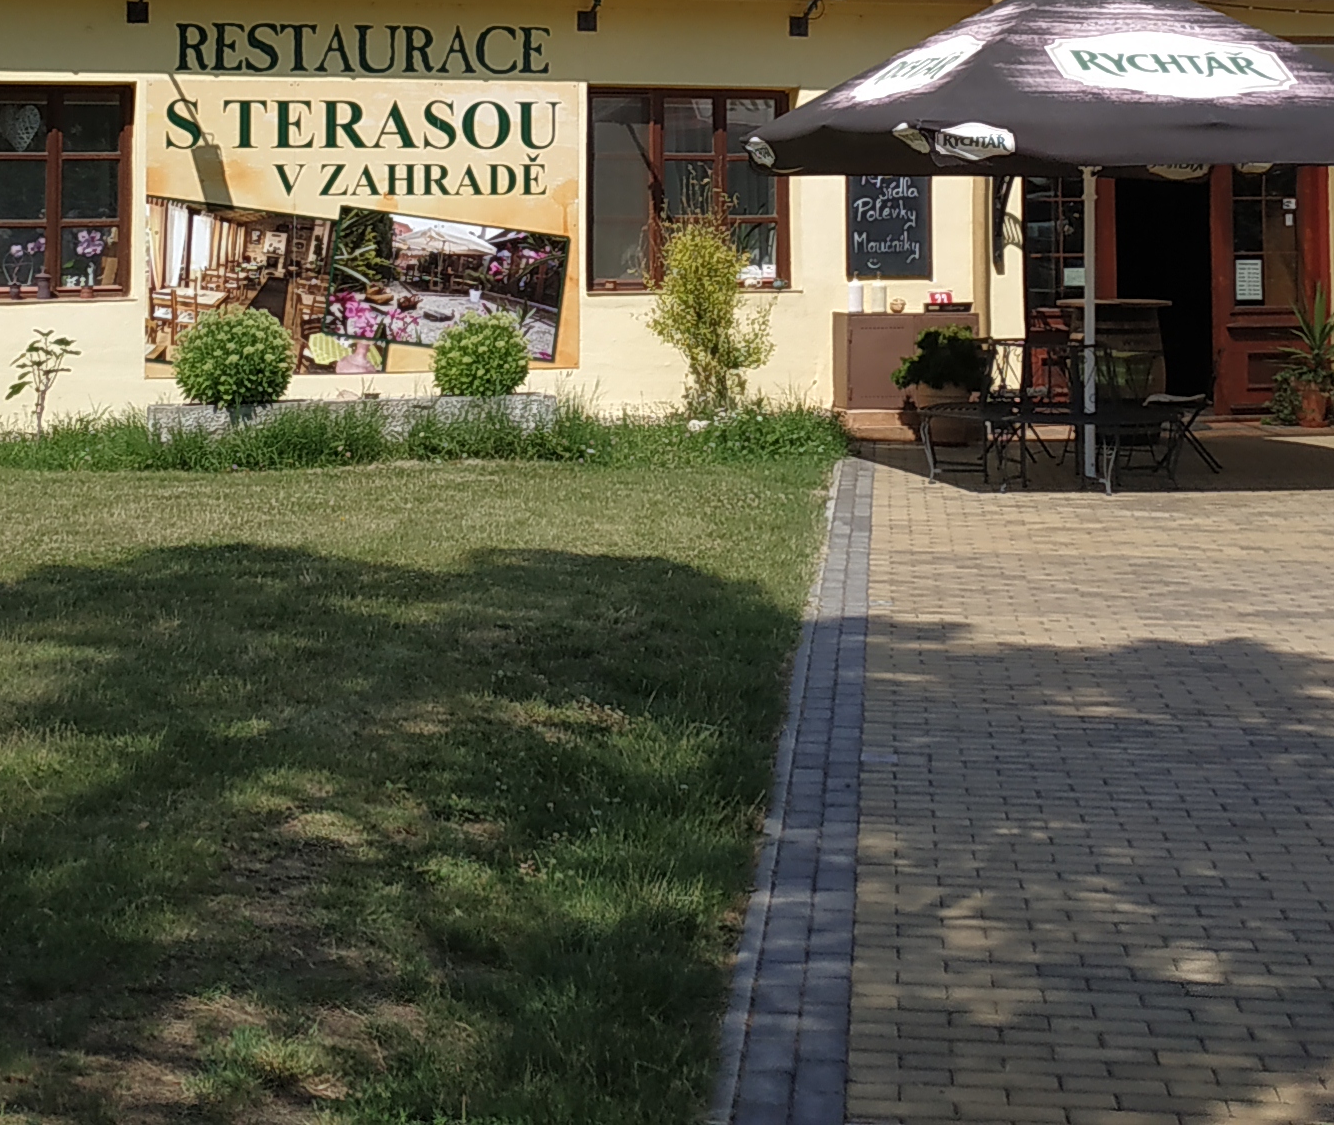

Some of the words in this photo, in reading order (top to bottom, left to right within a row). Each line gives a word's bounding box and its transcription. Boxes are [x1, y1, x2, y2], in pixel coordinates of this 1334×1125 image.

[175, 22, 551, 75] RESTAURACE
[1070, 48, 1280, 82] RYCHTÁŘ
[165, 97, 203, 150] S
[223, 99, 563, 150] TERASOU
[942, 133, 1012, 153] RYCHTÁŘ
[273, 163, 305, 196] V
[319, 153, 548, 196] ZAHRADĚ
